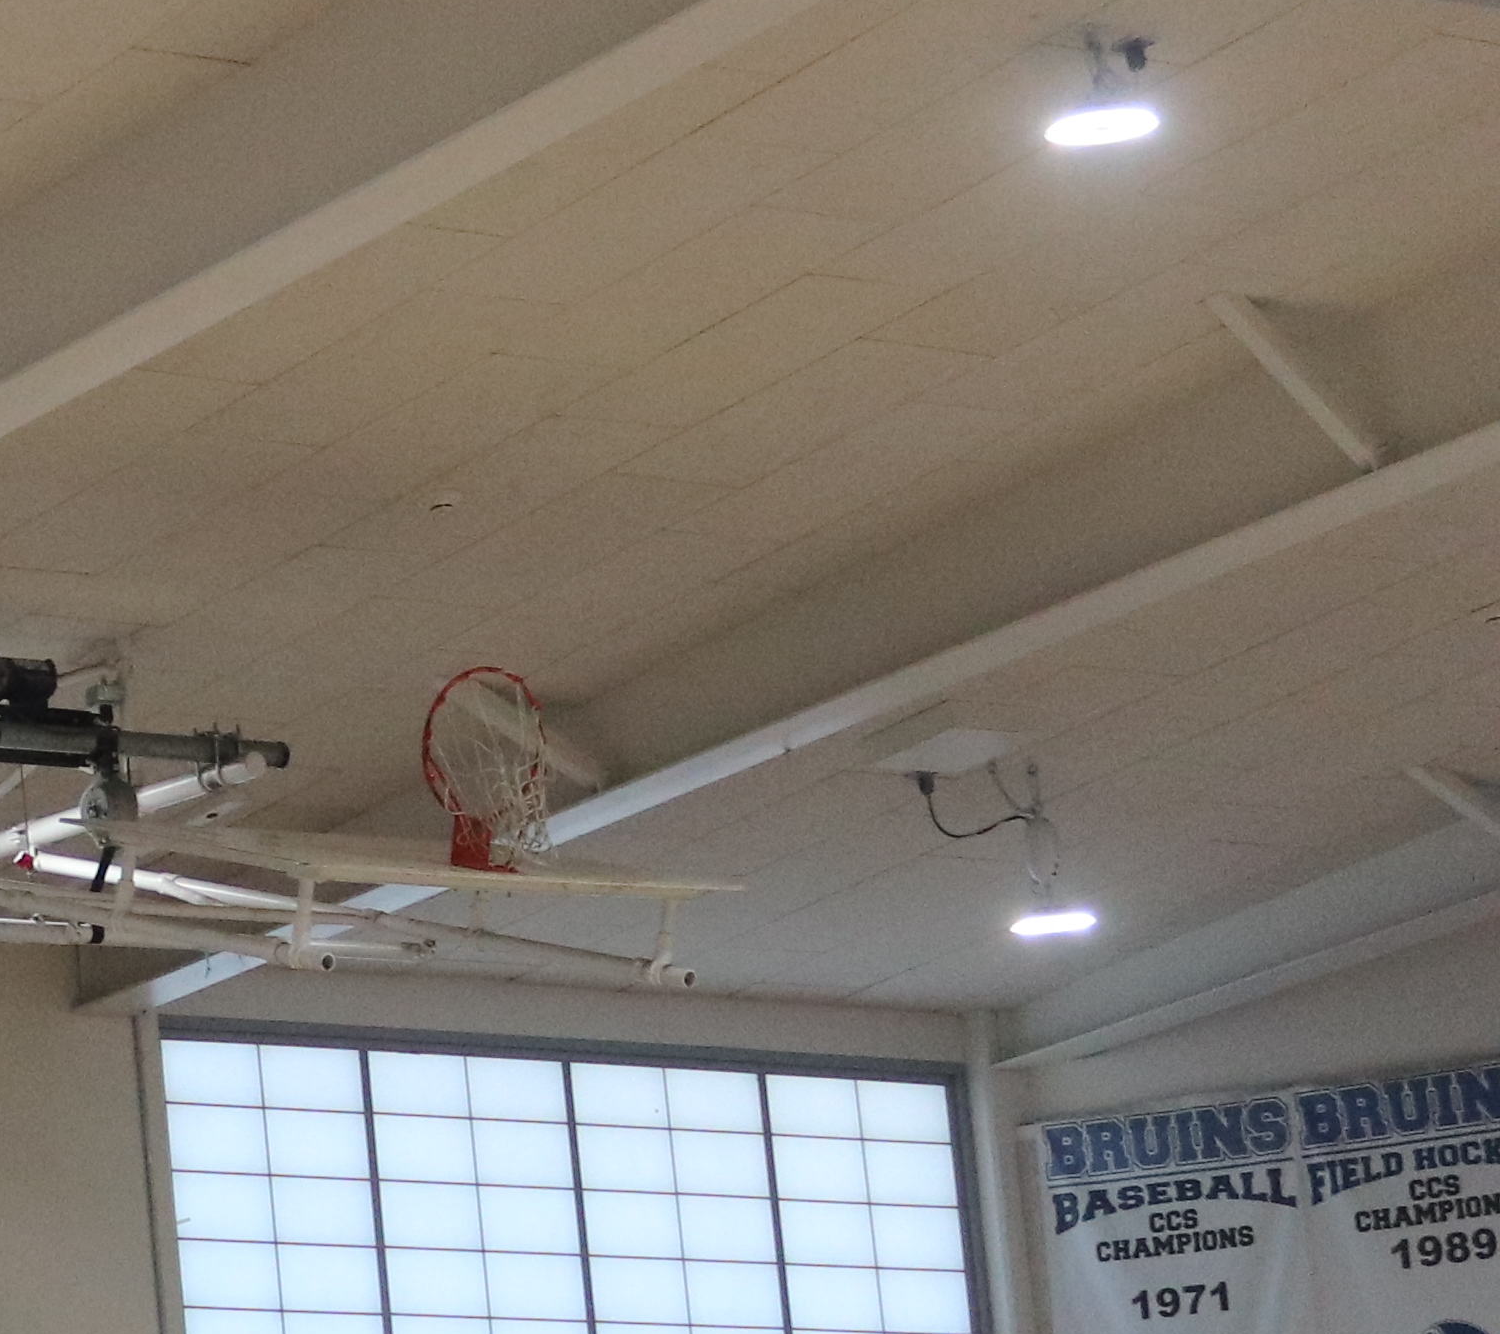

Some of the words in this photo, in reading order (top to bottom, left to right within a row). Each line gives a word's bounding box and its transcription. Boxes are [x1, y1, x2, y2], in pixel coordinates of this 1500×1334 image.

[1044, 1096, 1291, 1180] BRUINS
[1307, 1152, 1404, 1206] FIELD
[1408, 1174, 1460, 1201] CCS
[1053, 1167, 1297, 1234] BASEBALL
[1149, 1208, 1198, 1233] CCS
[1096, 1226, 1254, 1263] CHAMPIONS
[1390, 1228, 1497, 1269] 1989
[1132, 1281, 1230, 1320] 1971
